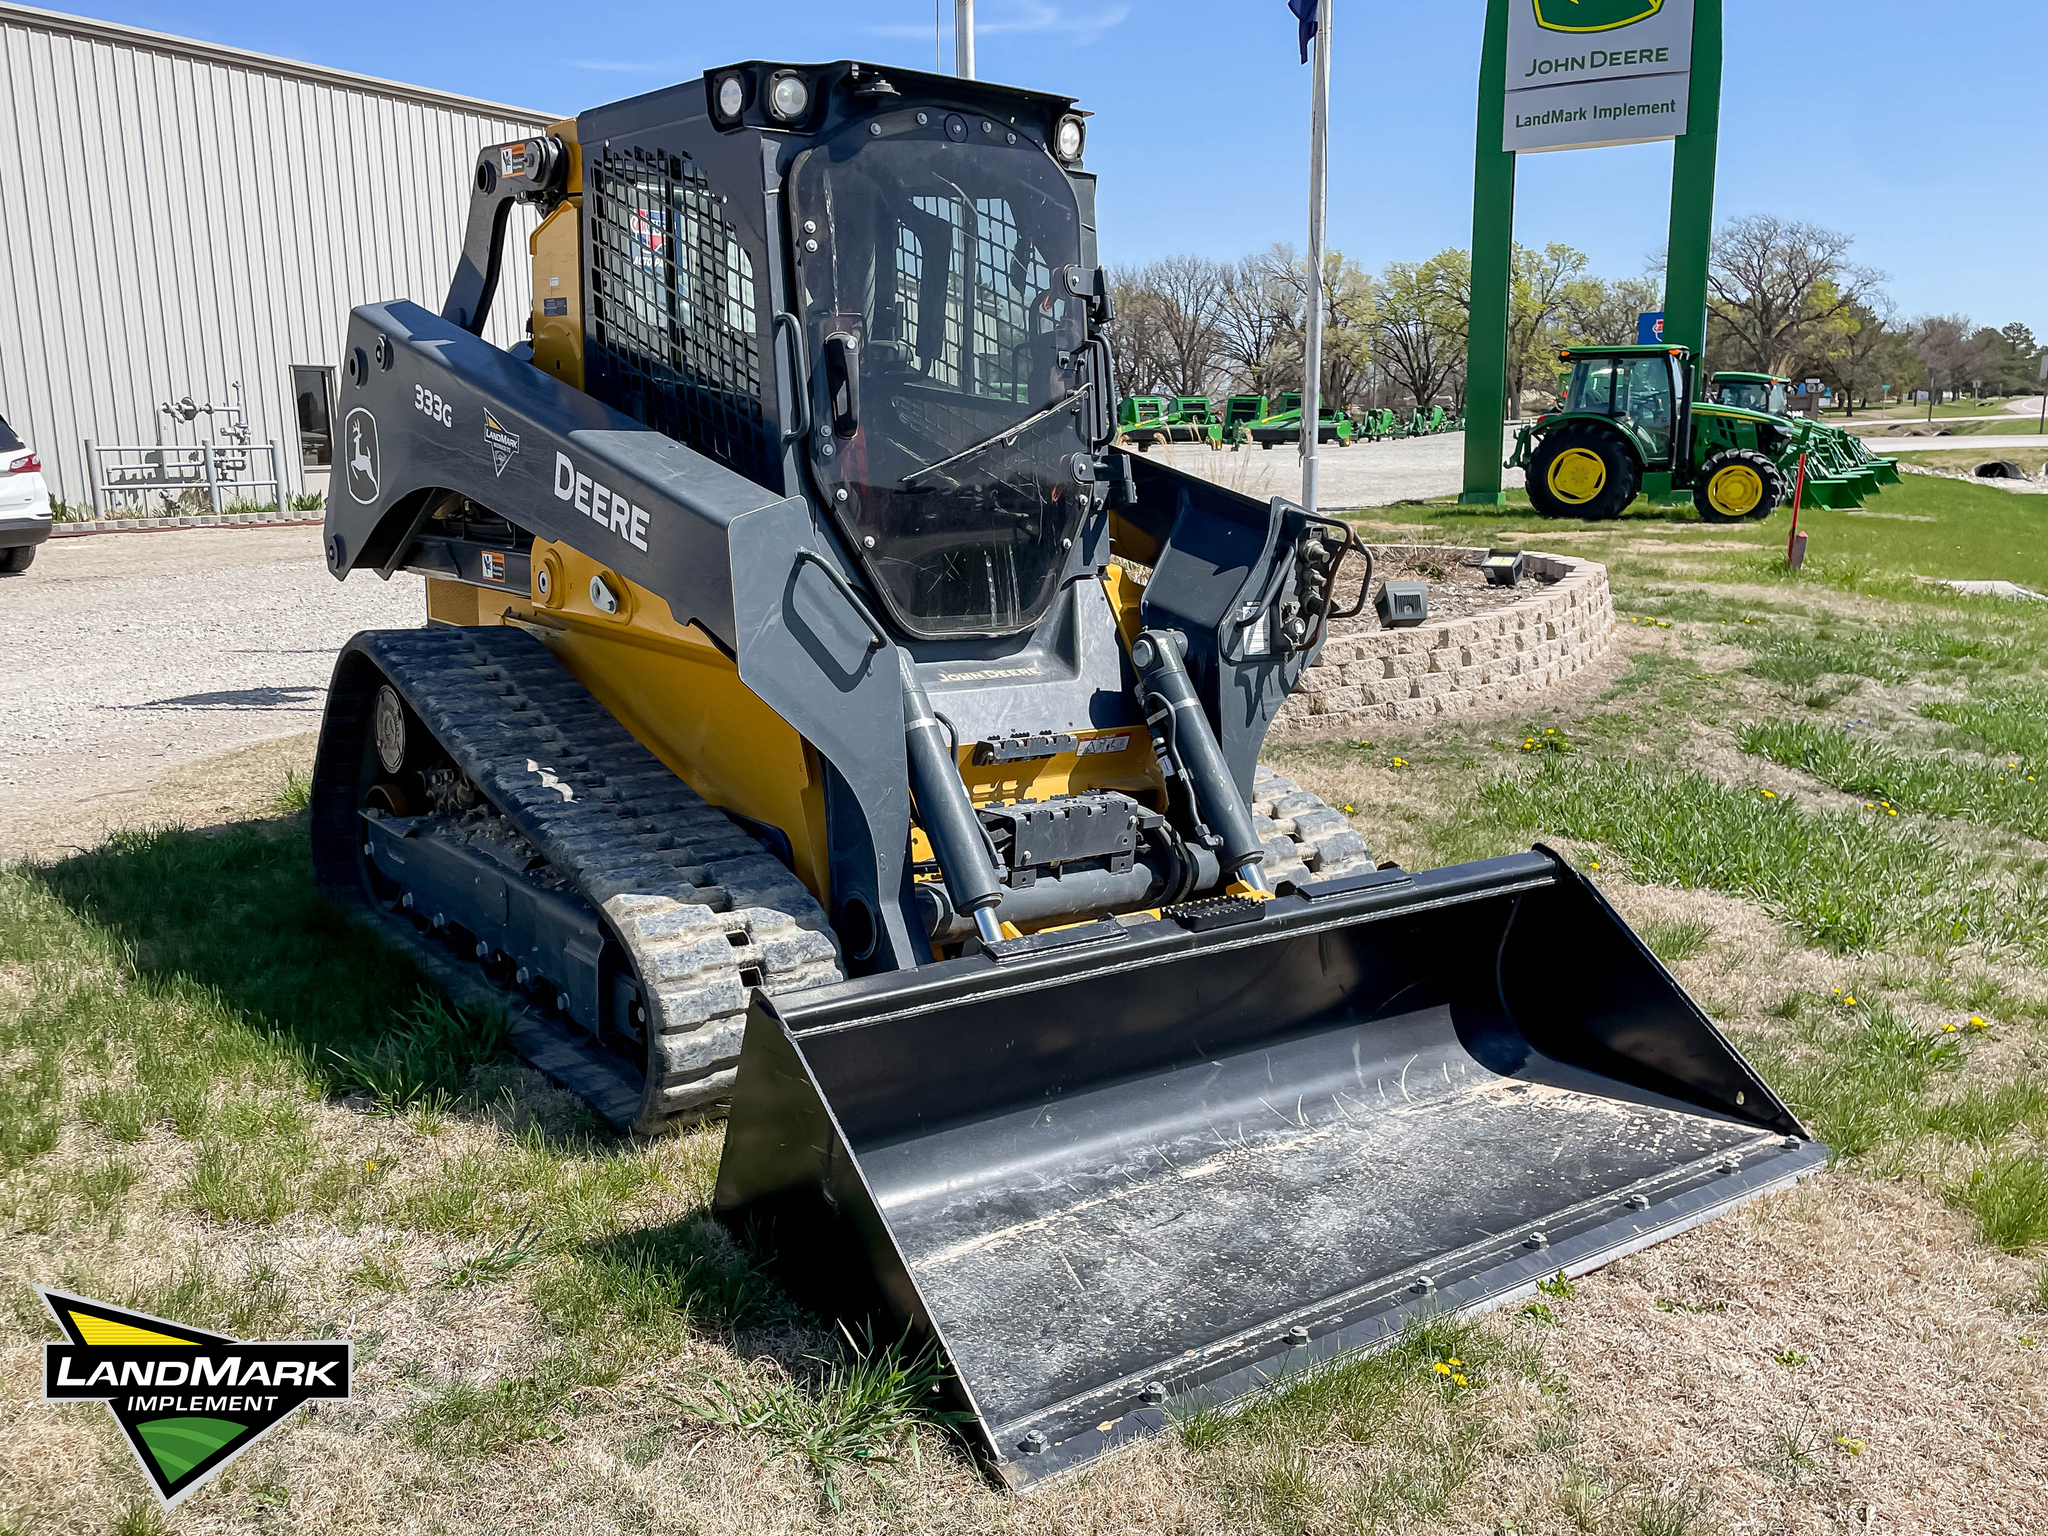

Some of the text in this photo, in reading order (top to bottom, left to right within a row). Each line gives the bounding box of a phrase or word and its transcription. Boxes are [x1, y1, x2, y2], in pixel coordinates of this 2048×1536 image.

[1525, 47, 1669, 77] JOHN DEERE
[1515, 99, 1676, 128] LandMark Implement
[414, 384, 452, 428] 333G
[554, 450, 650, 553] DEERE
[938, 667, 1044, 682] JOHN DEERE
